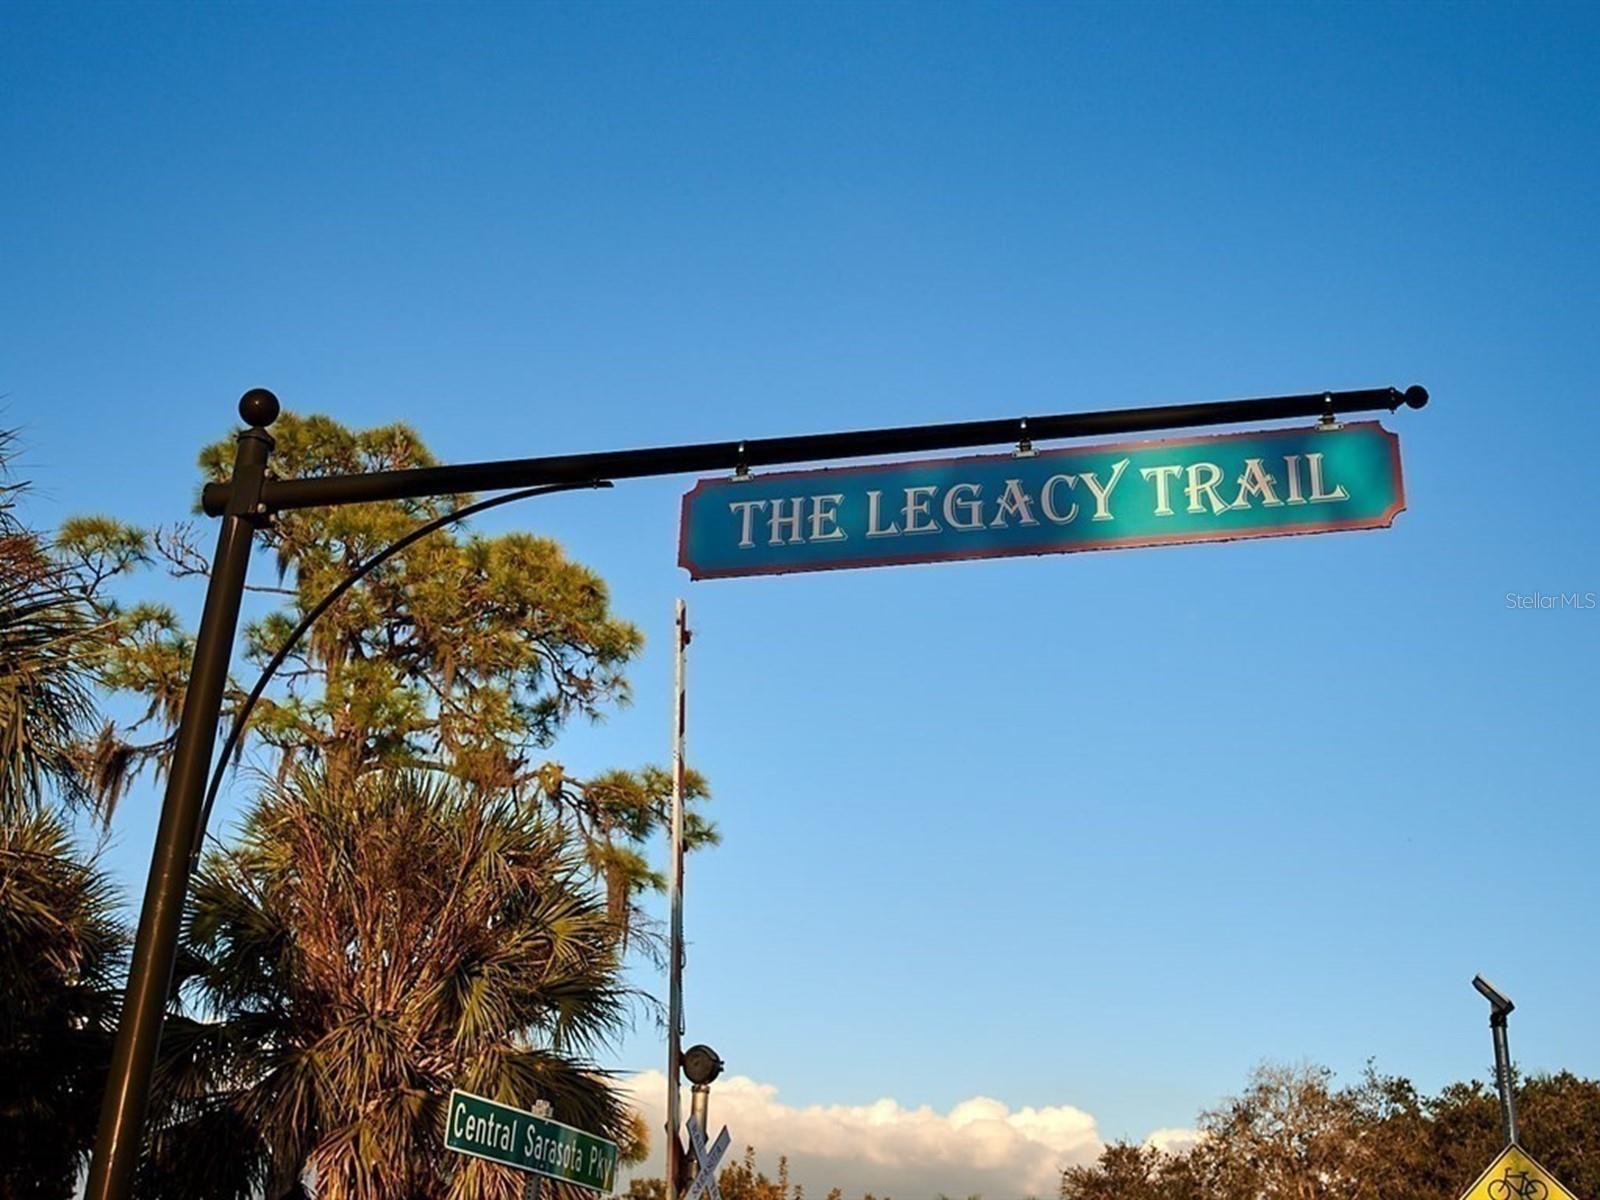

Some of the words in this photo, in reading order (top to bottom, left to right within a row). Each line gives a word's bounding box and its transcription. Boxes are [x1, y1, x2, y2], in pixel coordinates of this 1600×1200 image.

[729, 493, 848, 548] THE
[866, 458, 1131, 540] LEGACY
[1139, 452, 1351, 518] TRAIL
[454, 1102, 518, 1153] Central
[524, 1124, 583, 1172] Sarasota
[588, 1145, 613, 1189] Pky
